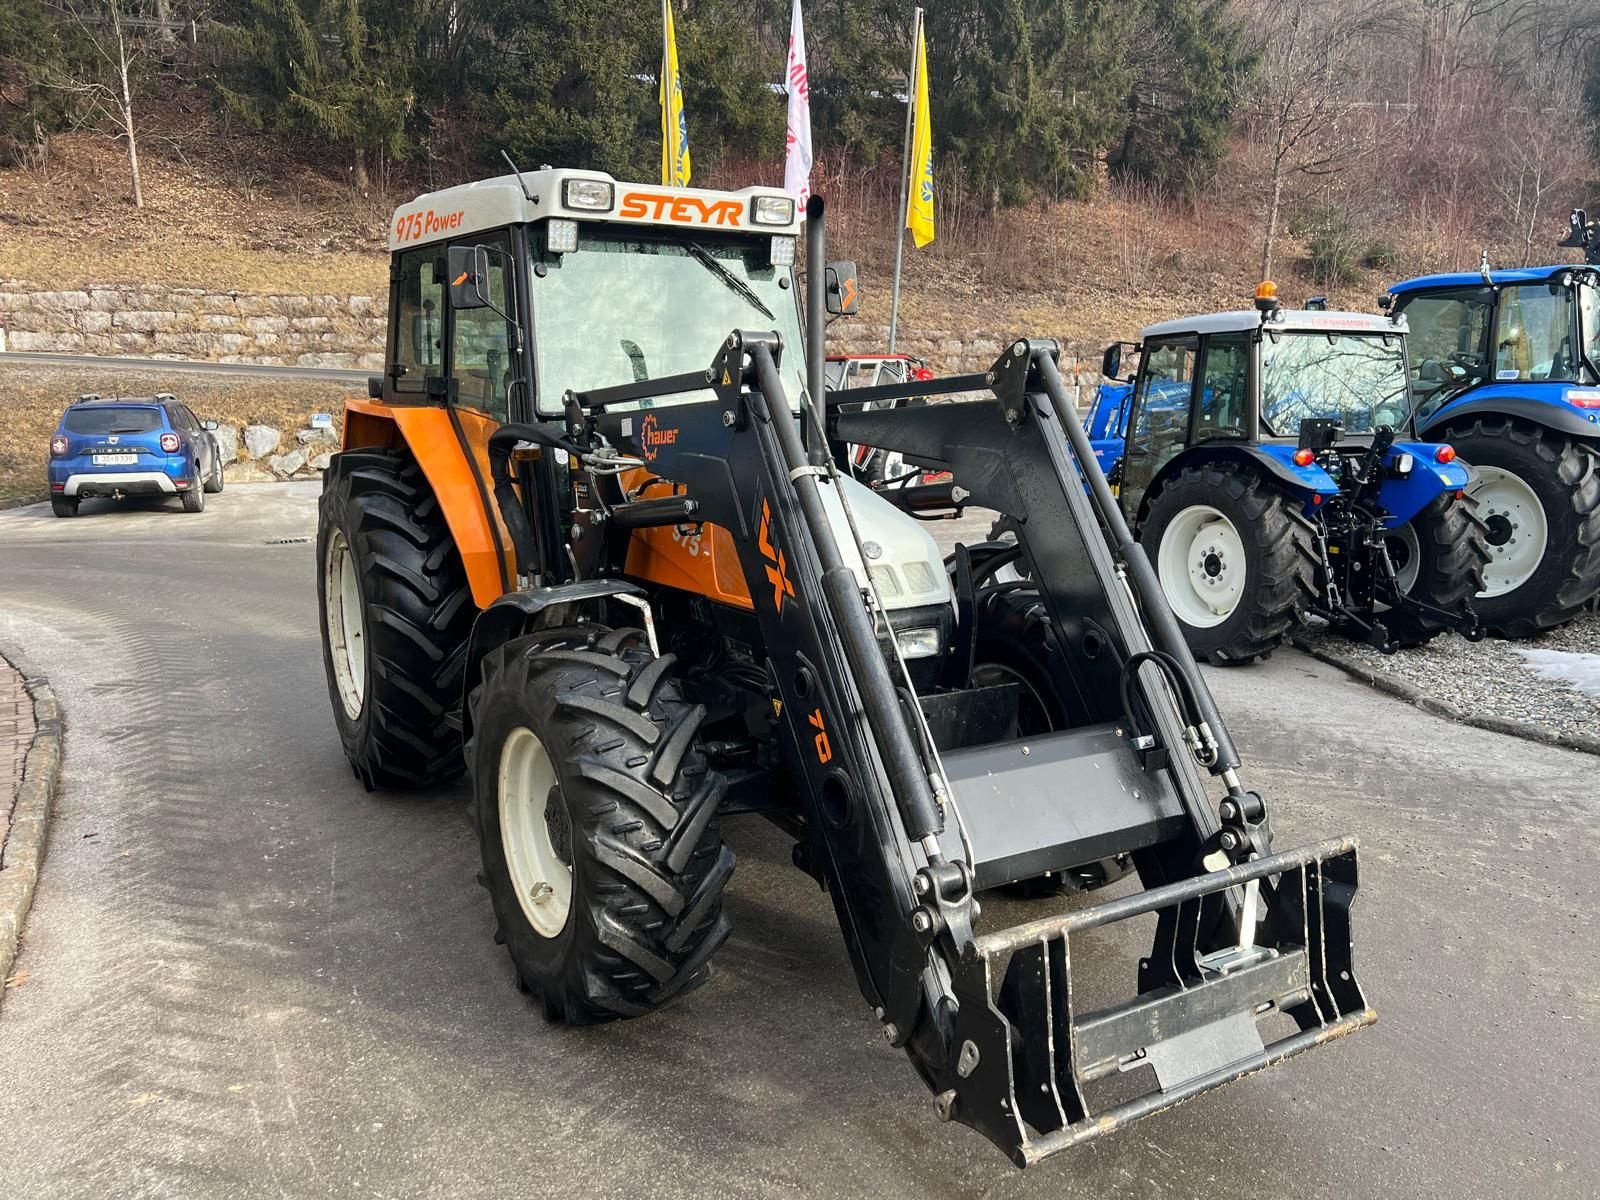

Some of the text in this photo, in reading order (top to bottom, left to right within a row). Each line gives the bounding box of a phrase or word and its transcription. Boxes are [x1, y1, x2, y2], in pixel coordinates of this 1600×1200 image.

[620, 192, 743, 226] STEYR
[396, 210, 464, 243] 975 Power
[647, 425, 679, 445] hauer
